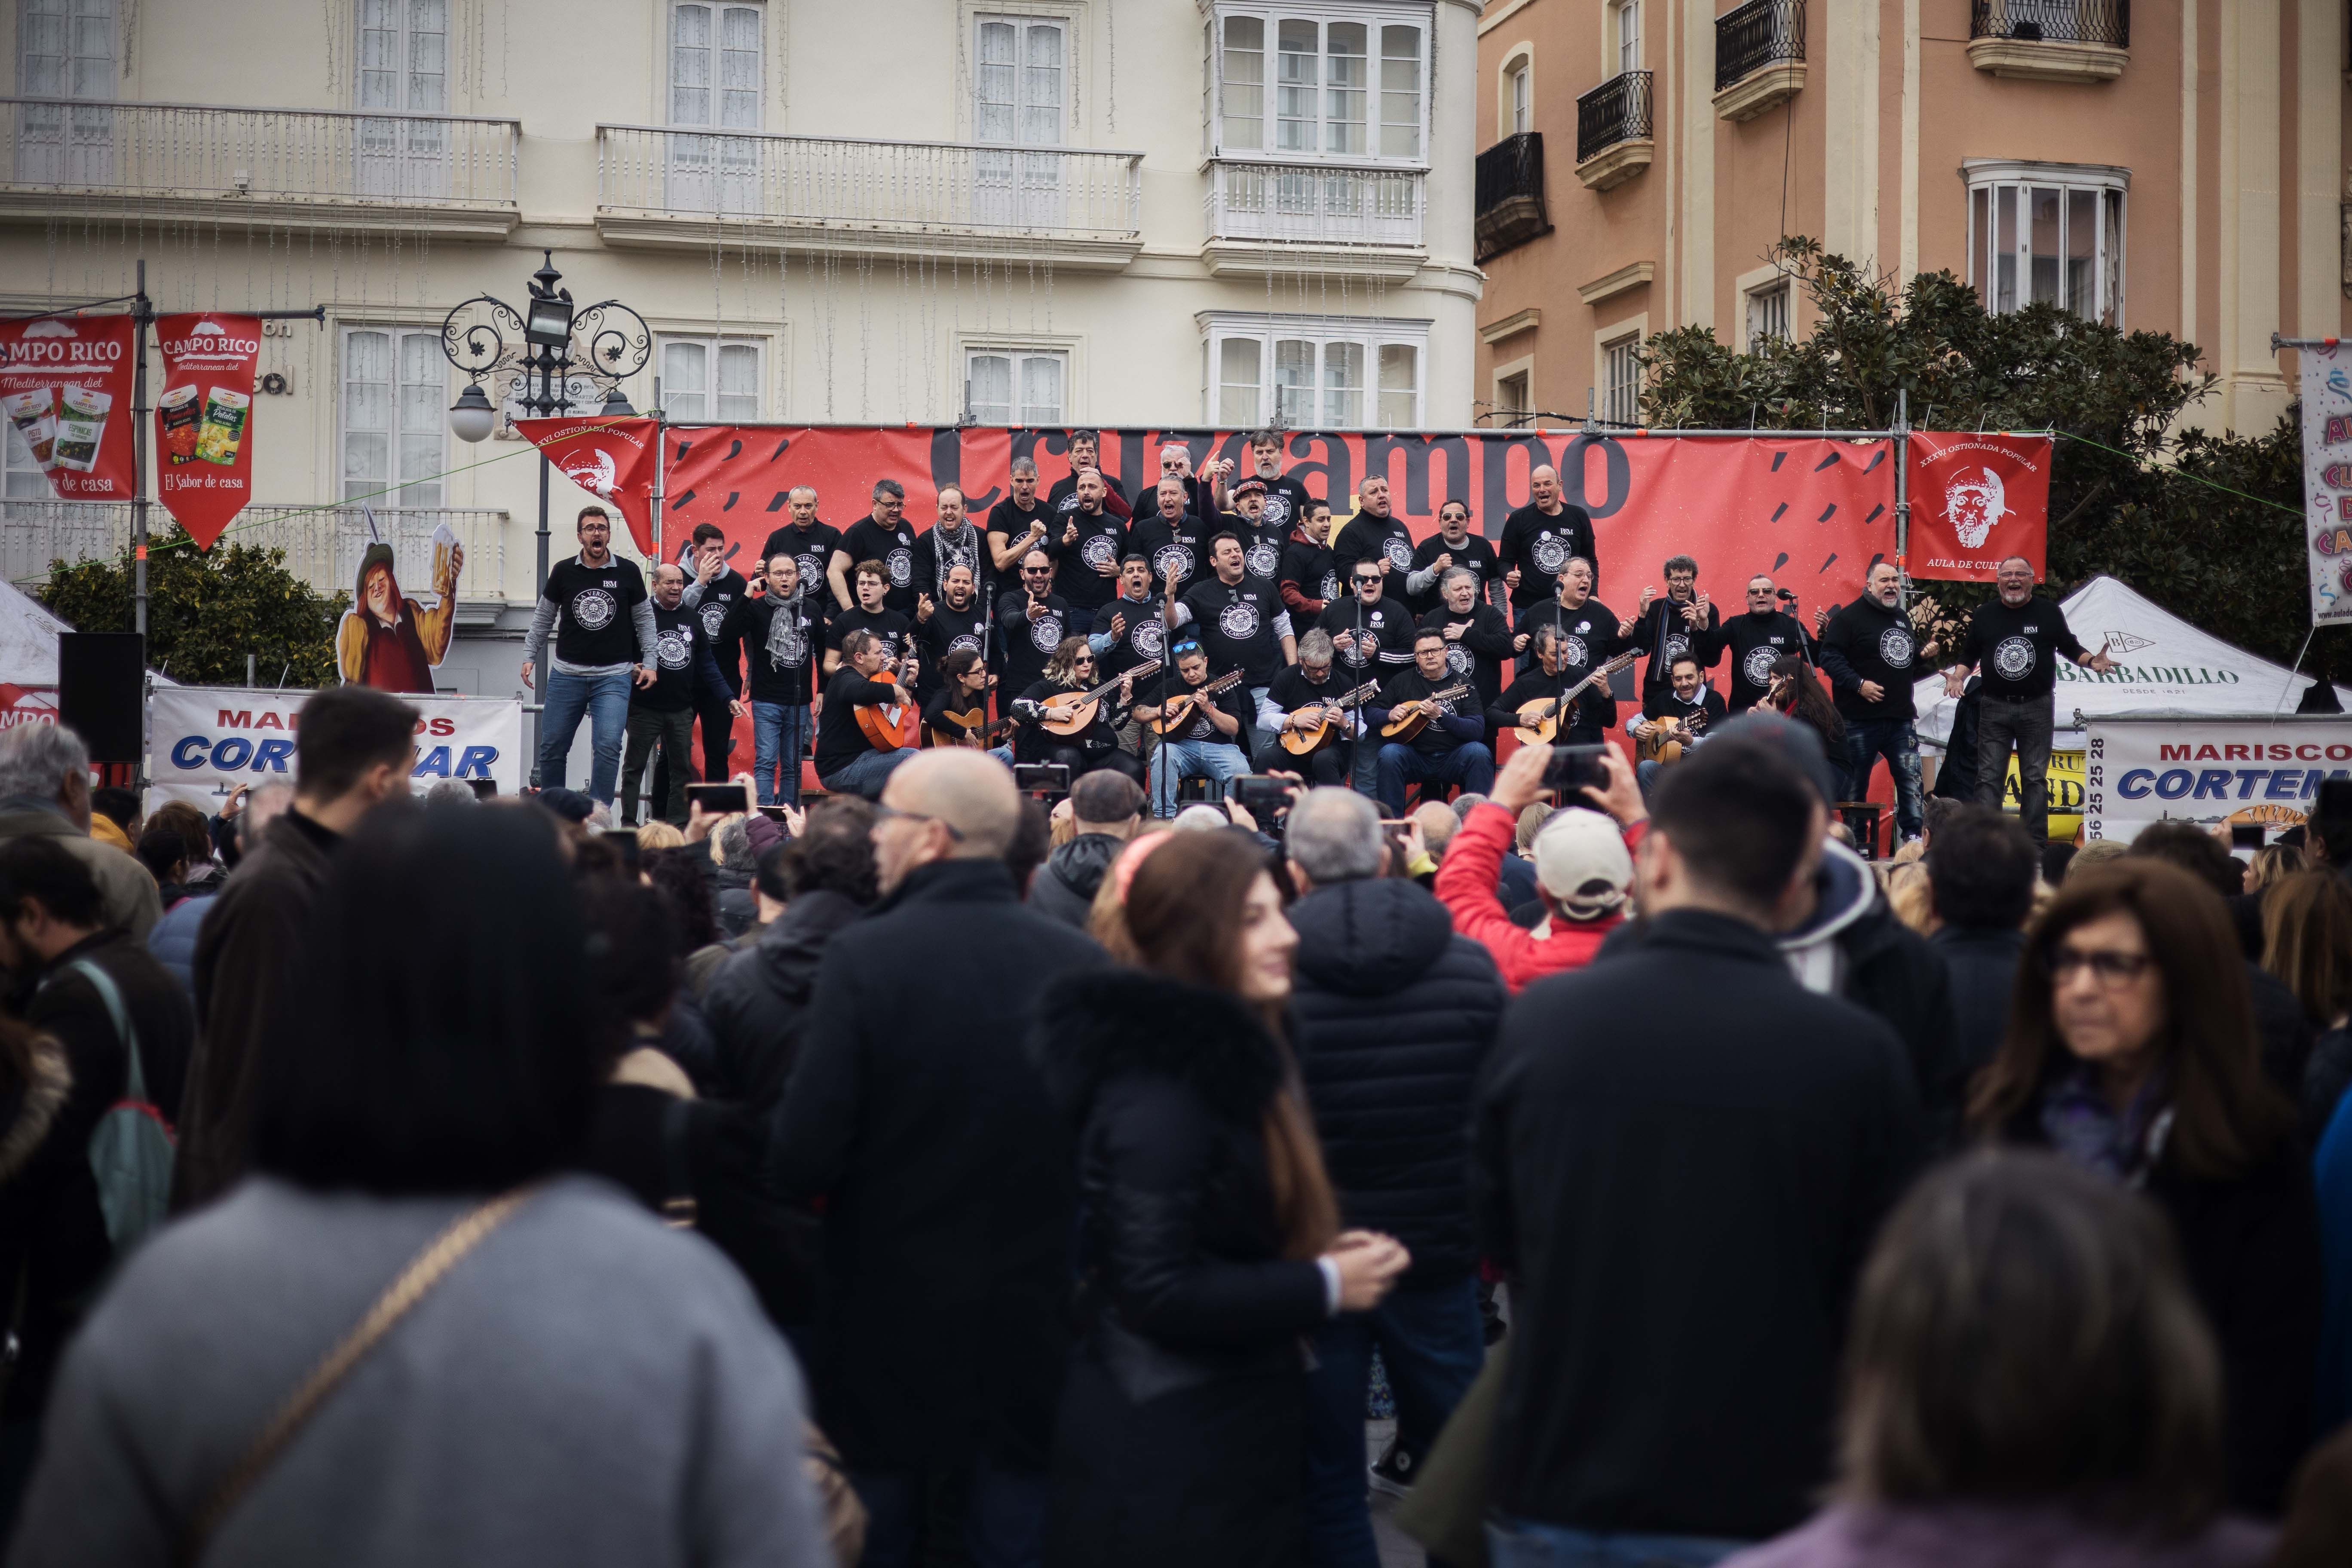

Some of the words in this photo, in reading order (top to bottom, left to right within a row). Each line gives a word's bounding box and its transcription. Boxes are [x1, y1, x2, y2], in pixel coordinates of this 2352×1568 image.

[69, 341, 121, 361] RICO
[163, 337, 214, 355] CAMPO
[217, 338, 257, 353] RICO
[226, 362, 239, 371] diet
[1, 377, 82, 389] Mediterranean
[84, 377, 103, 388] diet
[213, 409, 237, 423] Patatas
[554, 425, 605, 438] OSTIONADA
[607, 428, 645, 450] POPULAR
[1948, 442, 2000, 454] OSTIONADA
[2000, 447, 2037, 472] POPULAR
[62, 473, 76, 491] de
[81, 479, 113, 492] casa
[165, 474, 173, 490] El
[176, 474, 202, 490] Sabor
[205, 474, 216, 488] de
[220, 478, 243, 488] casa
[1550, 538, 1568, 548] ERITA
[1262, 545, 1277, 557] ERITA
[888, 555, 894, 564] LA
[1926, 558, 1954, 568] AULA
[1957, 560, 1972, 570] DE
[1975, 560, 2001, 570] CULT
[576, 594, 586, 603] LA
[700, 608, 707, 616] LA
[1224, 608, 1232, 616] LA
[581, 619, 608, 628] CARNAVAL
[677, 624, 691, 632] B&M
[1135, 627, 1143, 635] LA
[1228, 627, 1255, 637] CARNAVAL
[1134, 636, 1143, 650] CORO
[1999, 643, 2009, 651] LA
[2112, 637, 2121, 647] B
[882, 642, 897, 653] ERITA
[1749, 653, 1756, 661] LA
[1890, 657, 1911, 666] CARNAVAL
[660, 658, 687, 668] CARNAVAL
[2002, 668, 2030, 678] CARNAVAL
[2091, 738, 2104, 760] 28
[2090, 766, 2104, 787] 25
[2089, 793, 2103, 815] 25
